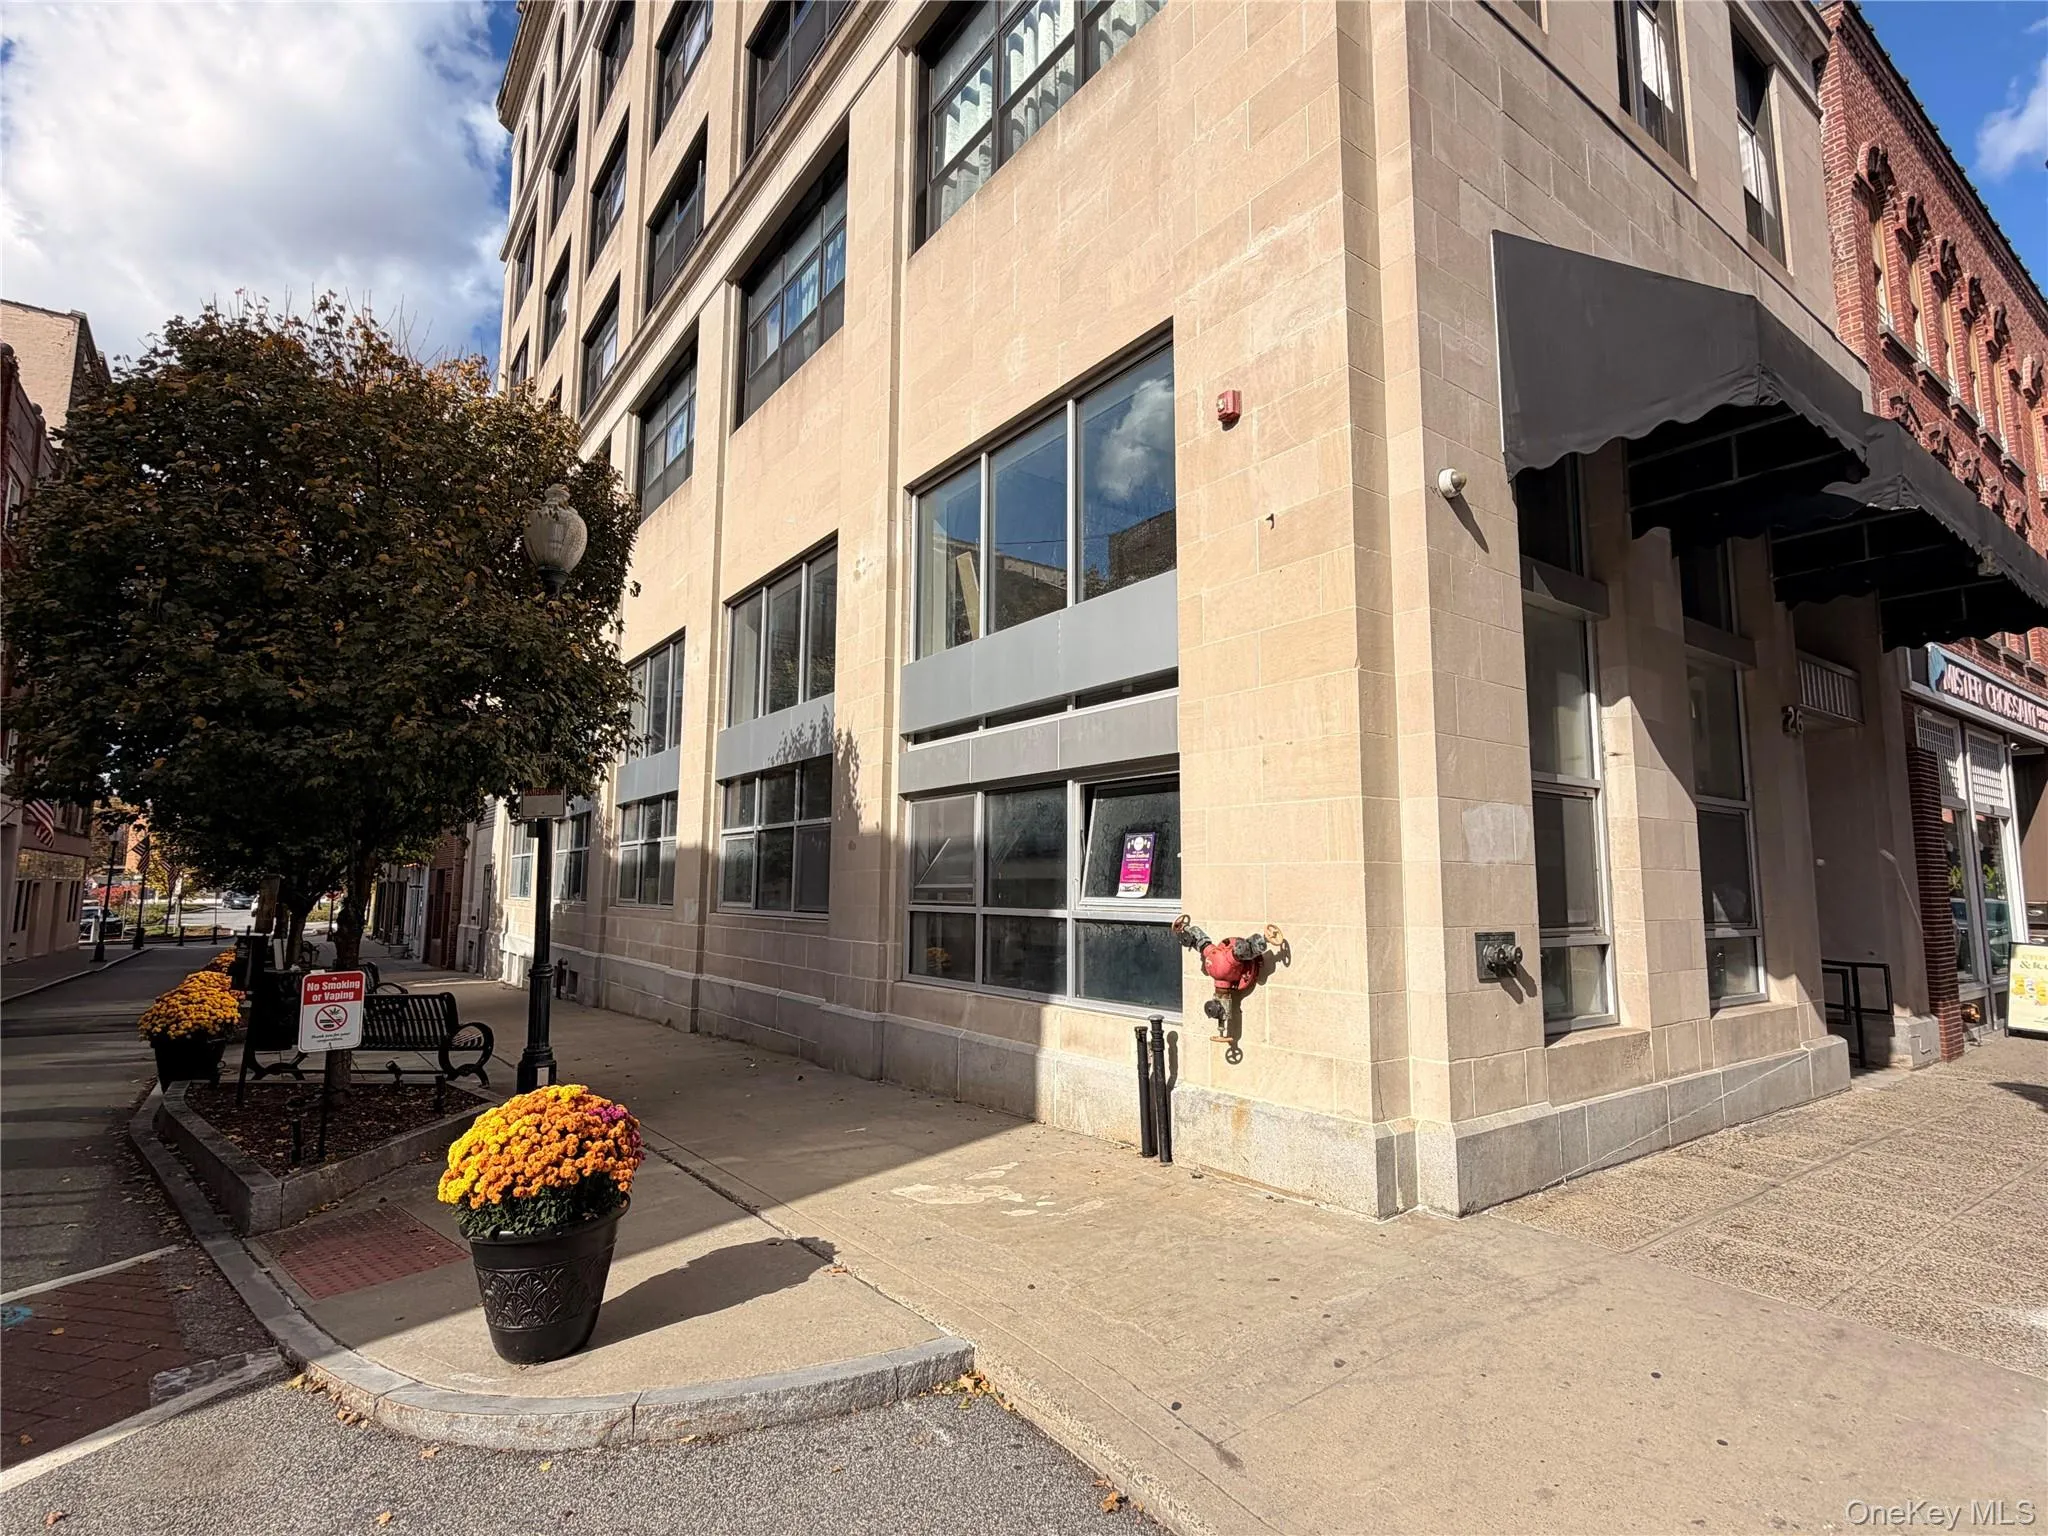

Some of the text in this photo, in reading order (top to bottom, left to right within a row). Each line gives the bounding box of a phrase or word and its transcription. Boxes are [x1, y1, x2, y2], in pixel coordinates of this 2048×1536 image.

[1943, 664, 2037, 728] MISTER CROISSANT
[1787, 706, 1804, 734] 26
[306, 980, 360, 992] No Smoking
[312, 991, 354, 1002] or Vaping
